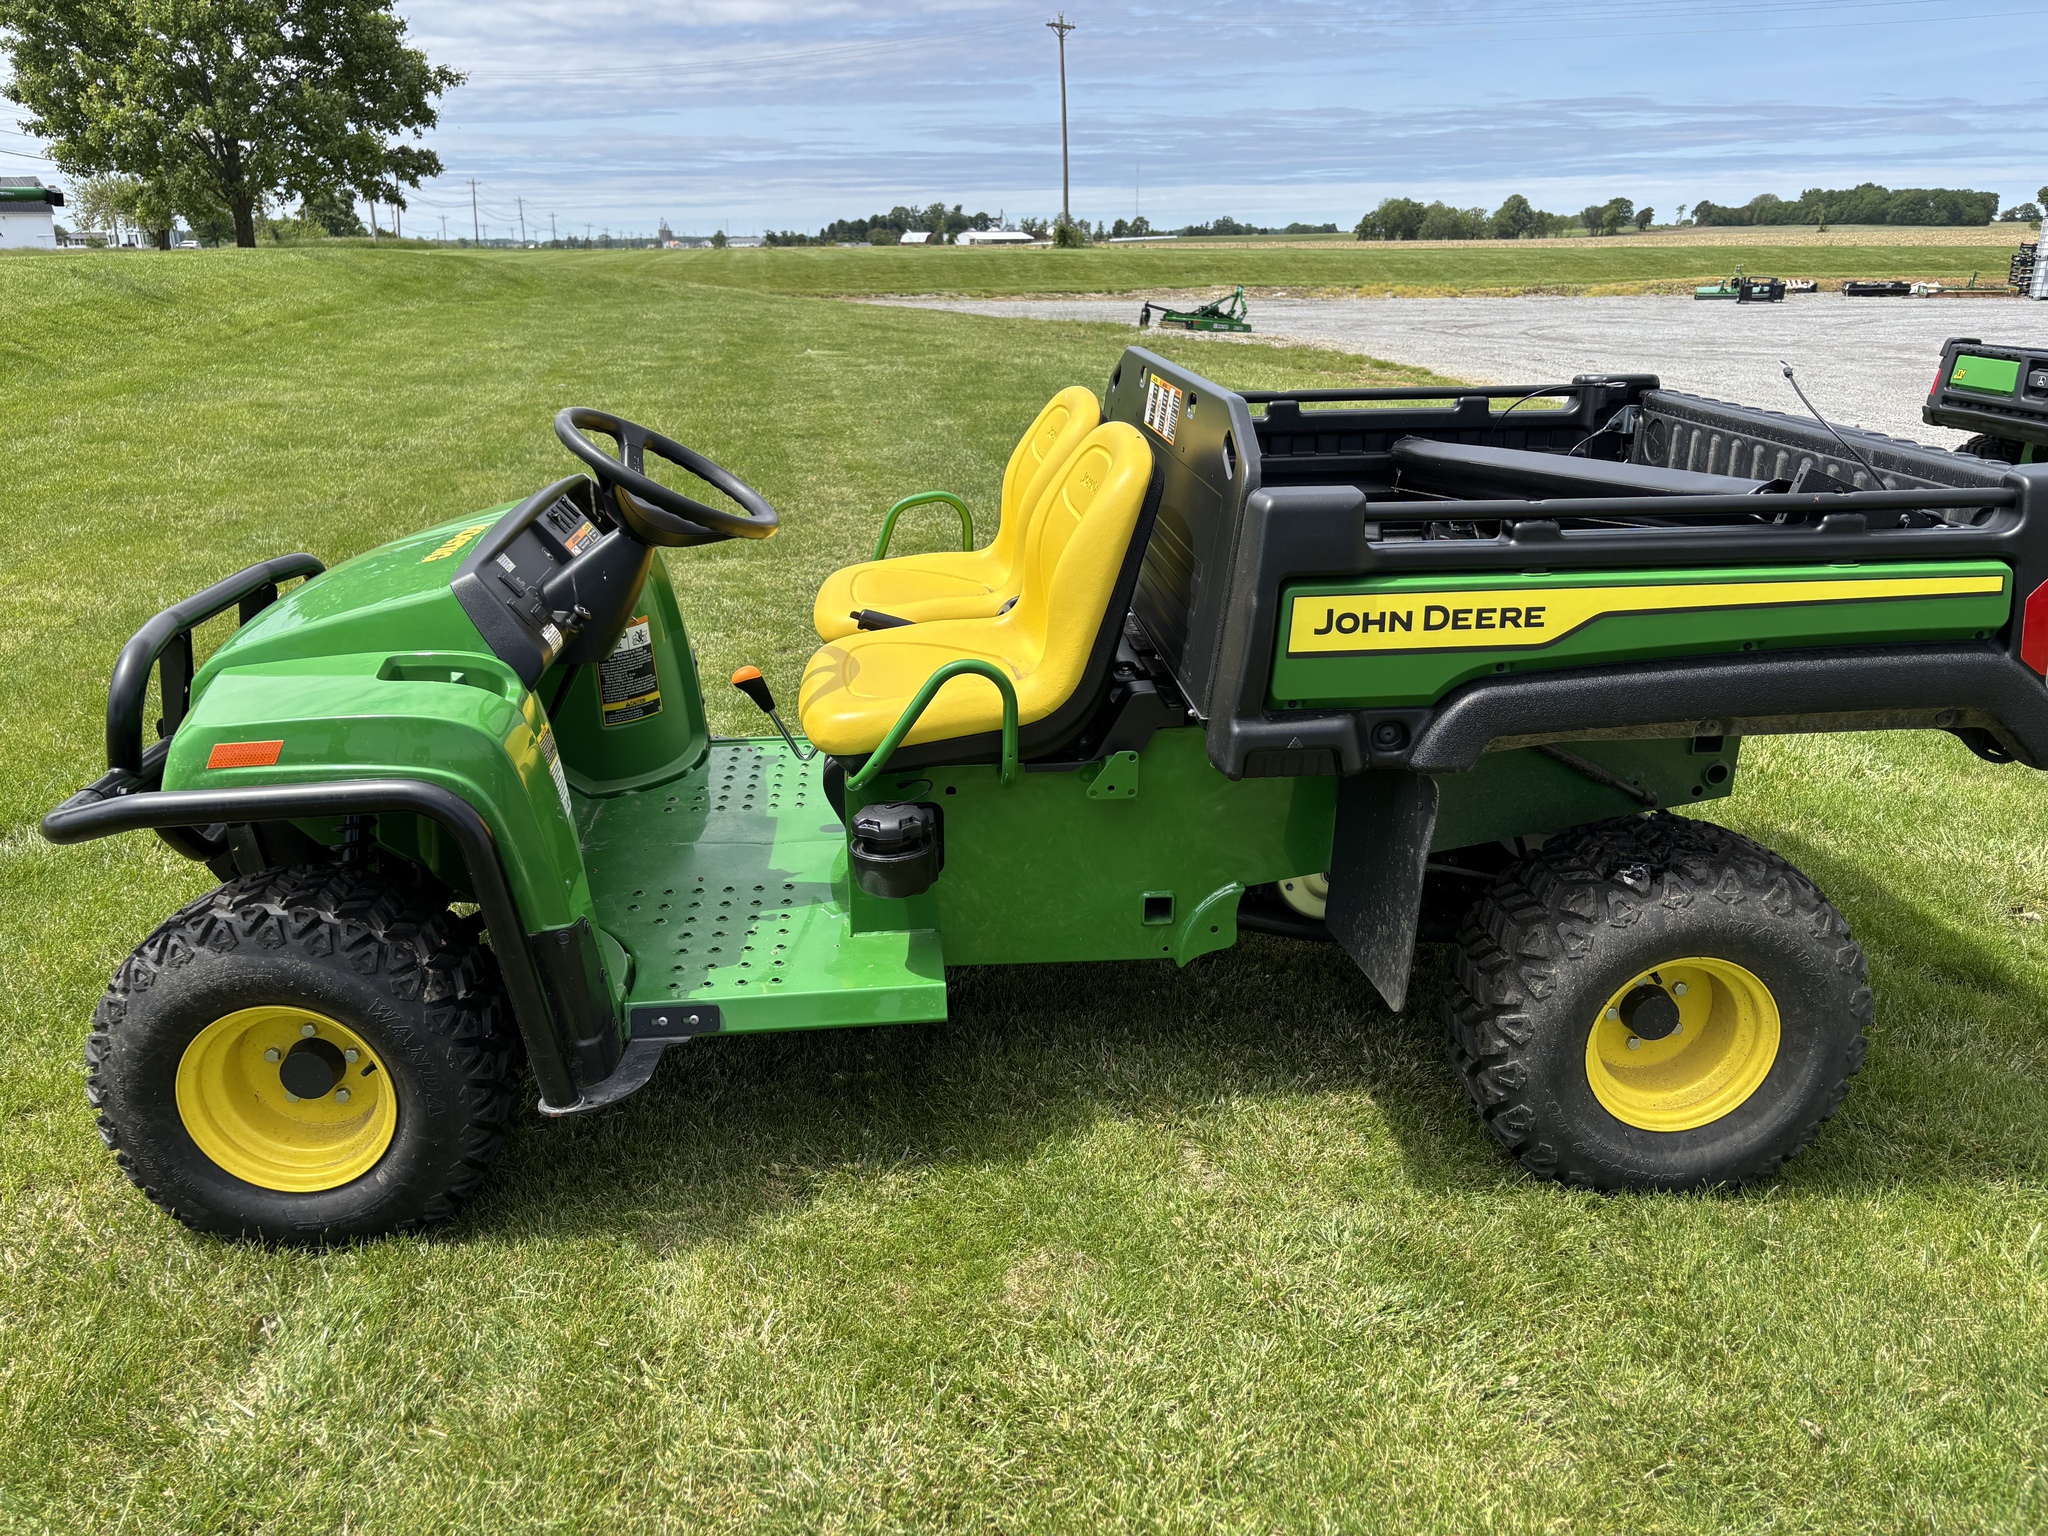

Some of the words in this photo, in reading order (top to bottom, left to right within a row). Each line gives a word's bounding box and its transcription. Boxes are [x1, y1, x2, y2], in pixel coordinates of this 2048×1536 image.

[1313, 608, 1413, 636] JOHN
[1423, 605, 1546, 632] DEERE
[367, 996, 447, 1118] WANDA
